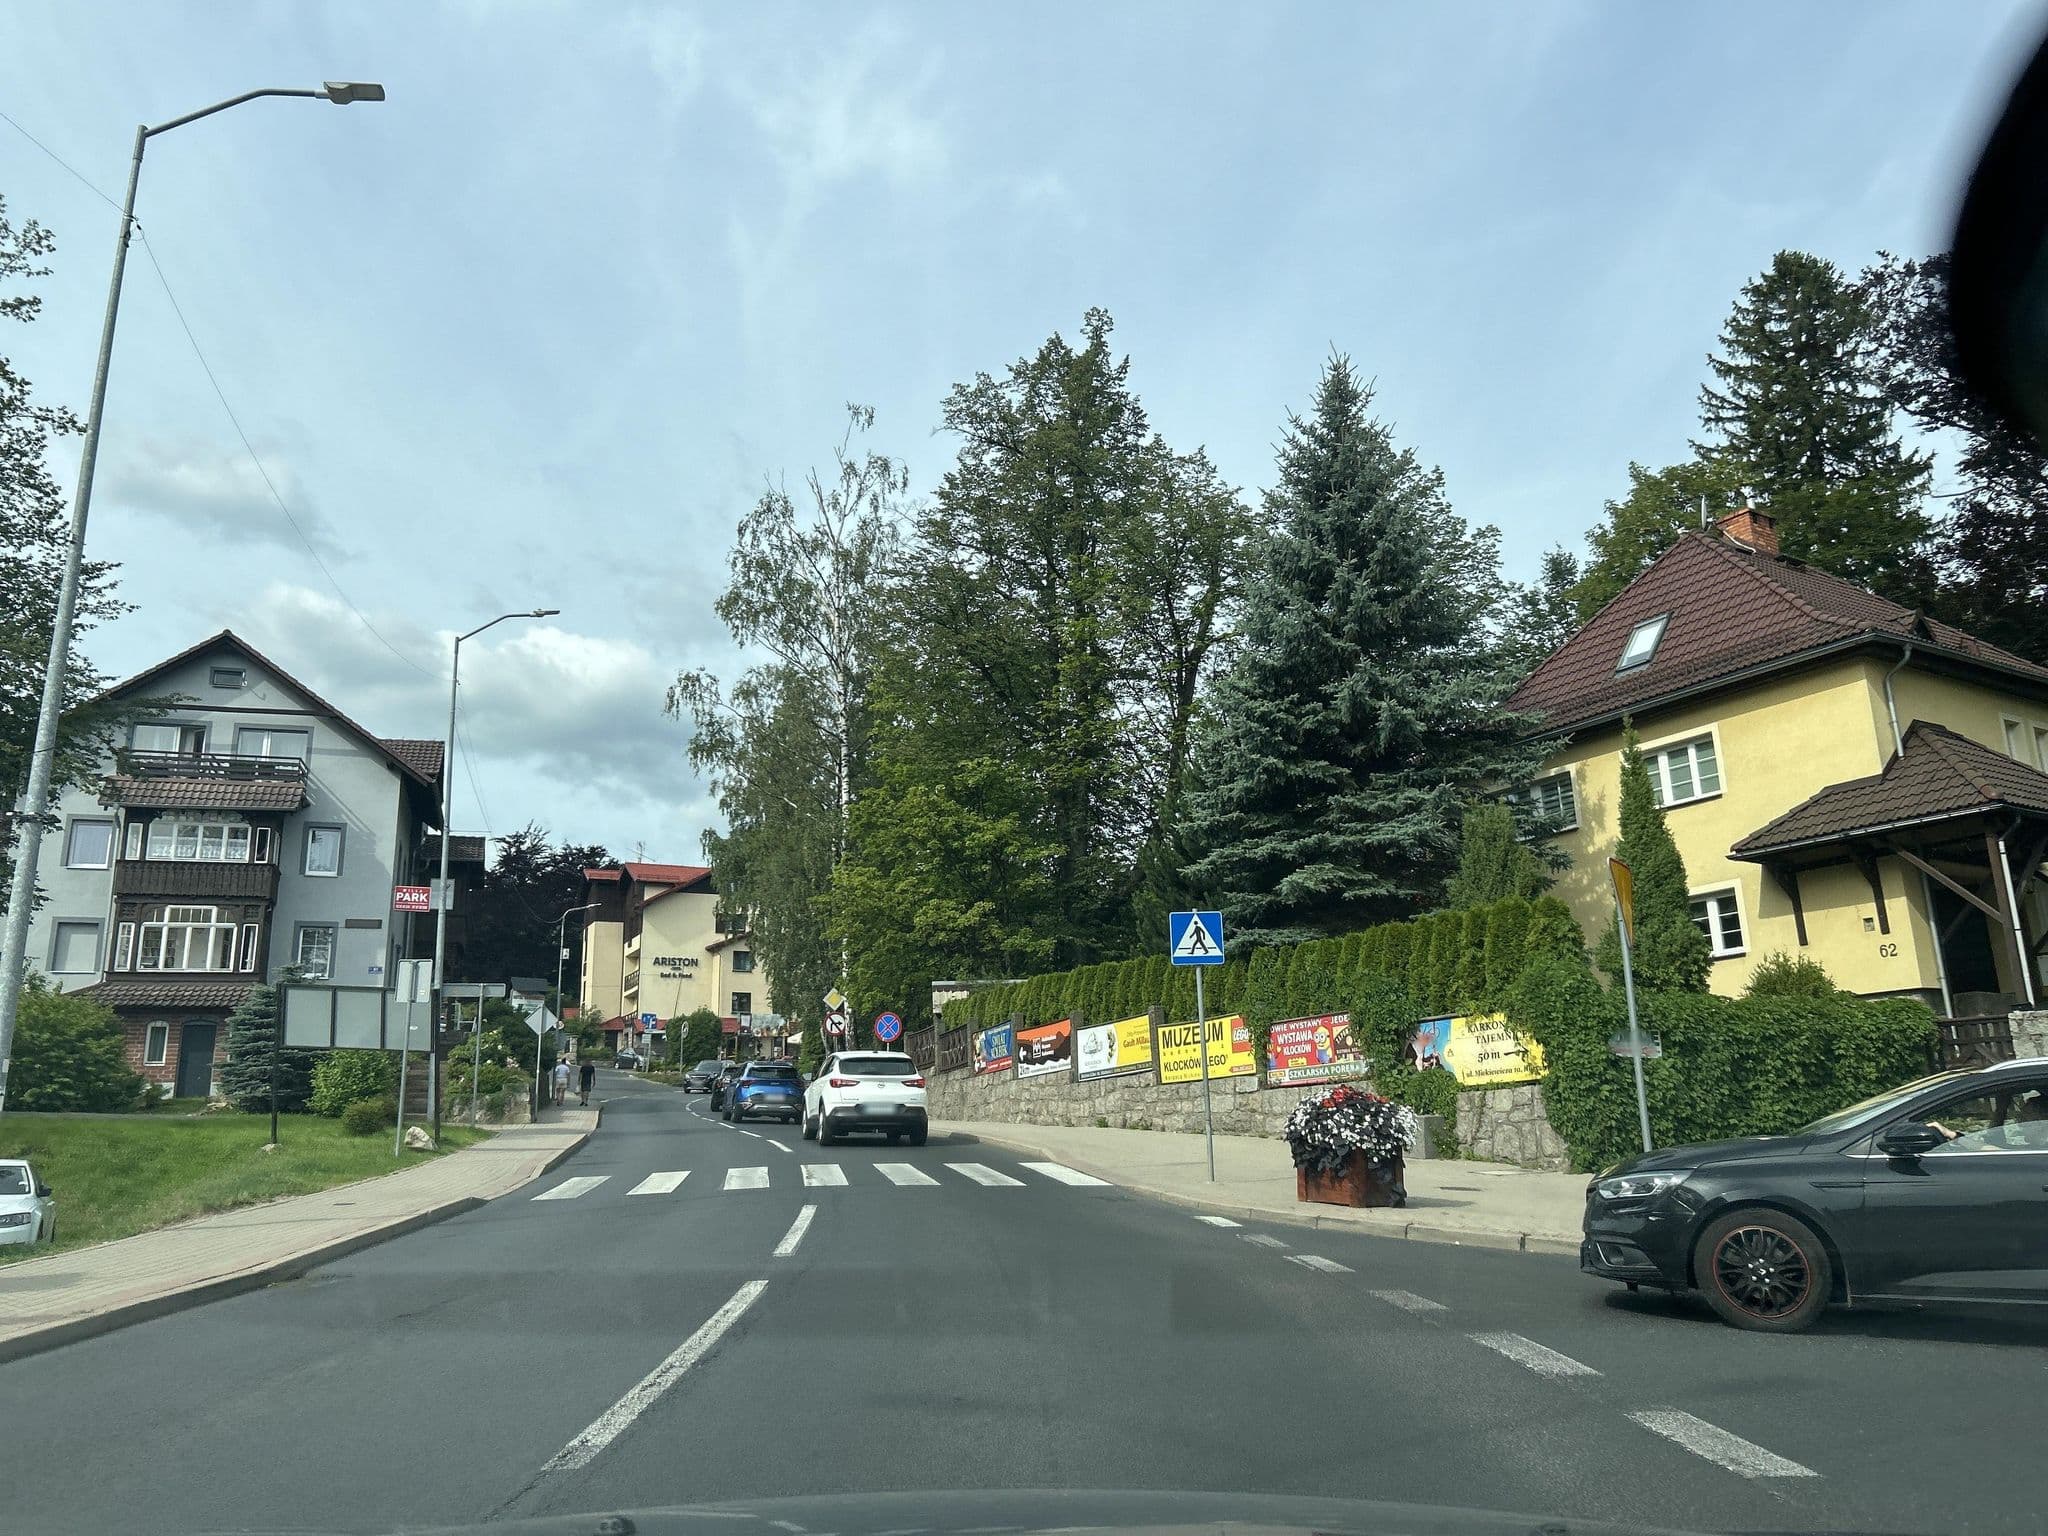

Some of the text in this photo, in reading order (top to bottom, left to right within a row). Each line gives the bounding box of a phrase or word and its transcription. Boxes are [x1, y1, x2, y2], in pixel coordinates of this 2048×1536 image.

[396, 892, 428, 902] PARK
[1880, 943, 1898, 957] 62
[653, 957, 698, 966] ARISTON
[1289, 1019, 1321, 1030] WYSTAWY
[1330, 1014, 1350, 1025] JEDE
[1467, 1020, 1506, 1034] KARKON
[1162, 1021, 1224, 1049] MUZEUM
[1233, 1028, 1248, 1040] LEGO
[1277, 1030, 1313, 1045] WYSTAWA
[1283, 1042, 1312, 1056] KLOCKÓW
[1164, 1056, 1201, 1072] KLOCKÓW
[1478, 1051, 1500, 1063] 50 m
[1289, 1069, 1329, 1079] SZKLARSKA
